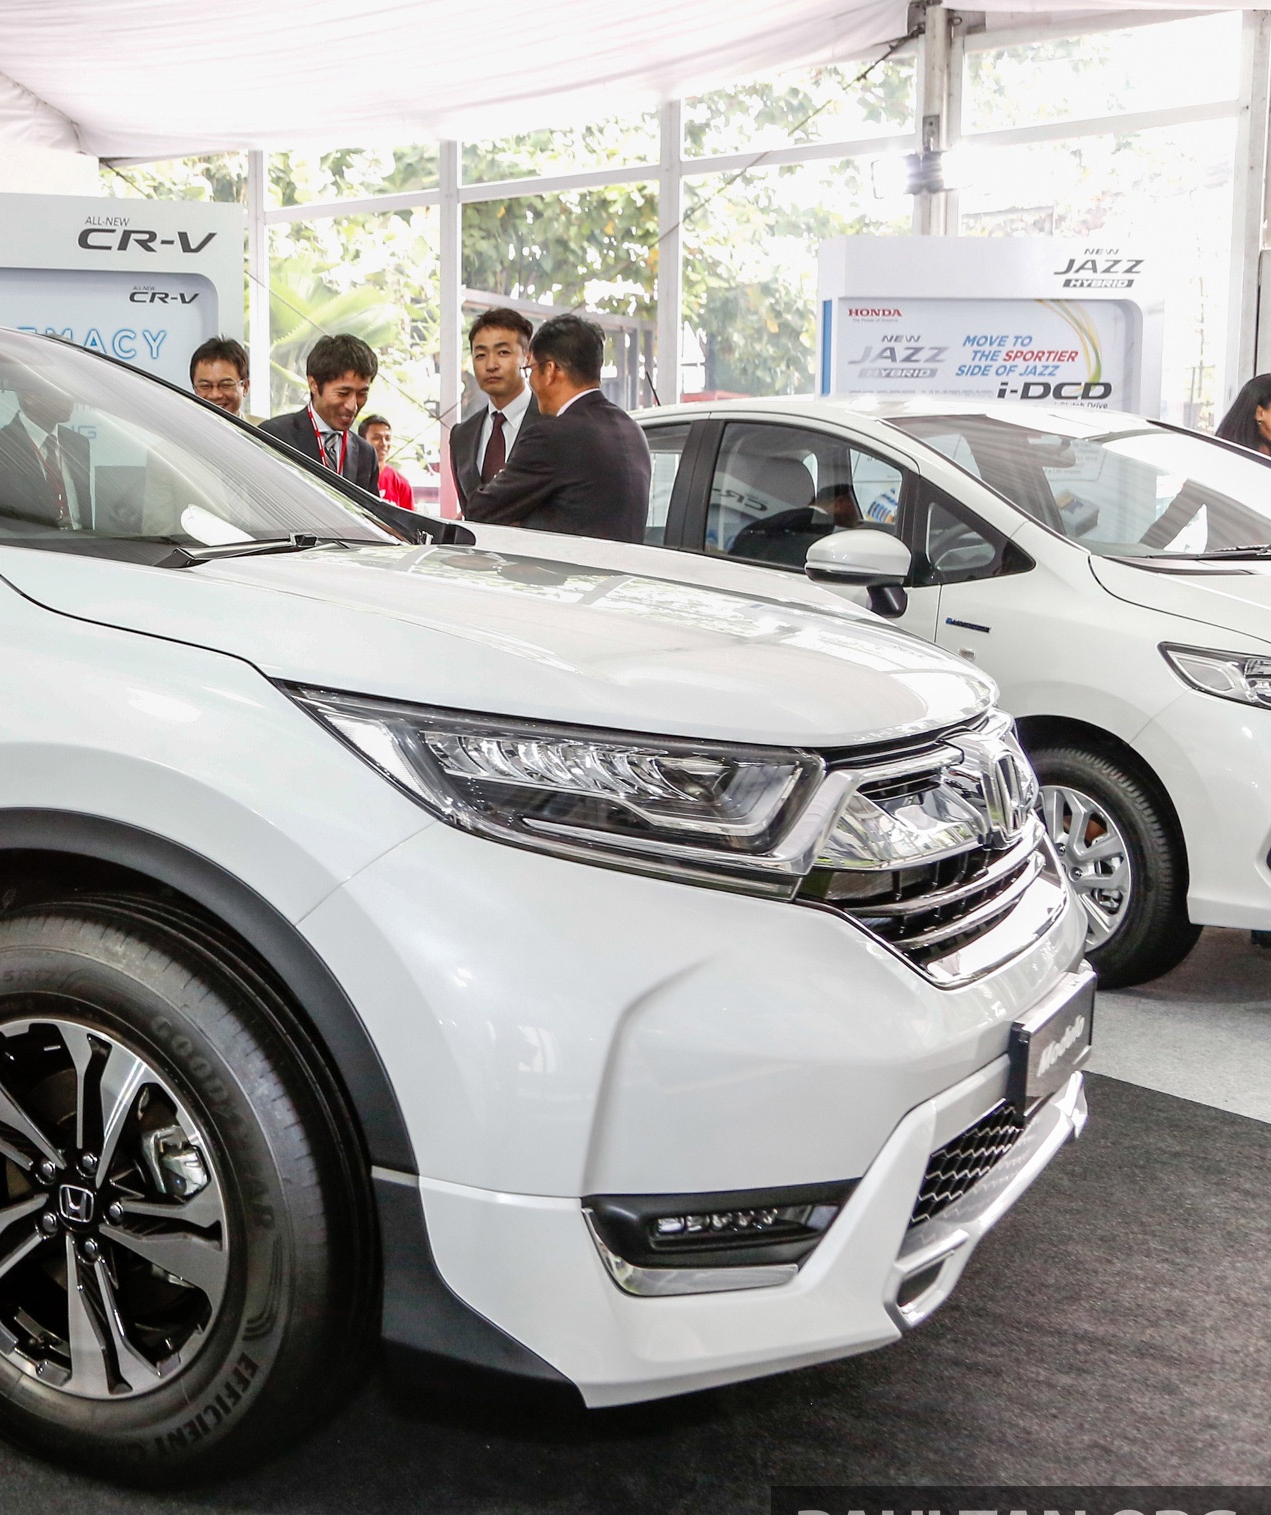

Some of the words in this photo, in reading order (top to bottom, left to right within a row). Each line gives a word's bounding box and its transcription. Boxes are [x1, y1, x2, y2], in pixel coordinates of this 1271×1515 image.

[85, 216, 130, 227] ALL-NEW
[77, 228, 218, 254] CR-V
[1053, 258, 1145, 275] JAZZ
[1068, 279, 1131, 288] HYBRID
[129, 291, 200, 305] CR-V
[848, 308, 902, 317] HONDA
[17, 326, 167, 360] ACY
[881, 334, 921, 343] NEW
[962, 335, 1008, 347] MOVE
[1012, 335, 1033, 347] TO
[847, 346, 950, 365] JAZZ
[971, 350, 1001, 362] THE
[1003, 350, 1079, 362] SPORTIER
[955, 364, 991, 377] SIDE
[995, 364, 1018, 377] OF
[1019, 365, 1060, 377] JAZZ
[997, 381, 1113, 400] i-DCD
